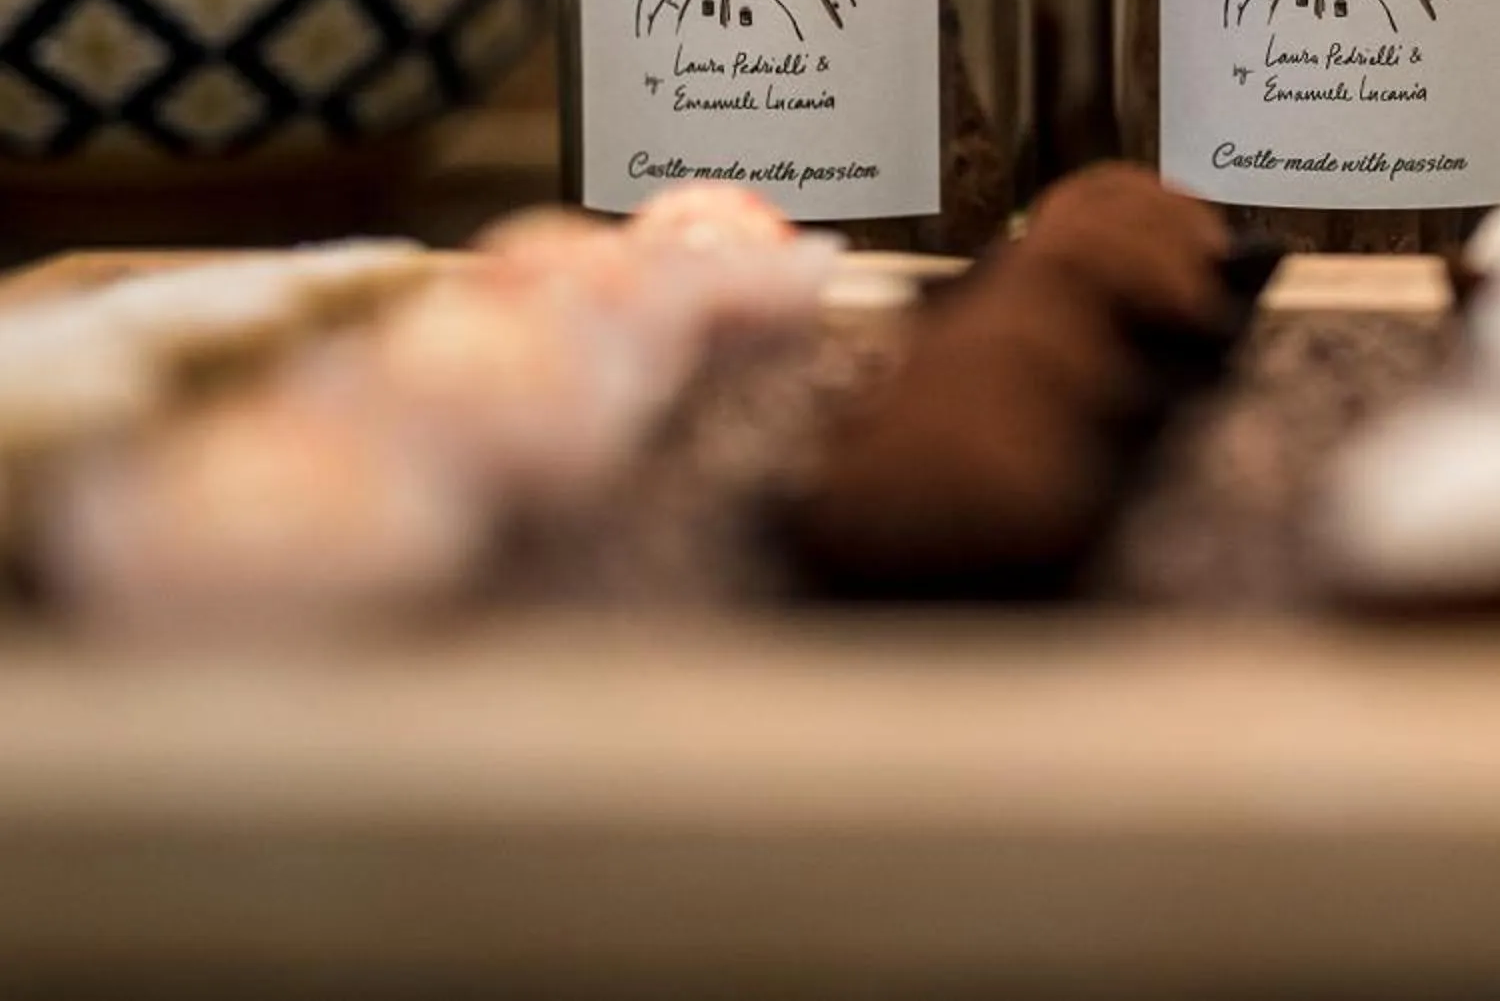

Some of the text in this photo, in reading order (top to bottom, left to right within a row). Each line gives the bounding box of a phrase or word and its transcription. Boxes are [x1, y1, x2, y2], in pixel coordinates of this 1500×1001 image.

[673, 44, 725, 76] Laura
[816, 55, 830, 72] &
[1265, 34, 1319, 67] Laura
[1409, 47, 1422, 63] &
[673, 84, 759, 111] Emanuele
[1264, 74, 1427, 102] Emanuele Lucania
[749, 161, 798, 181] with
[798, 160, 880, 189] passion
[1212, 142, 1468, 181] Castle-made with passion
